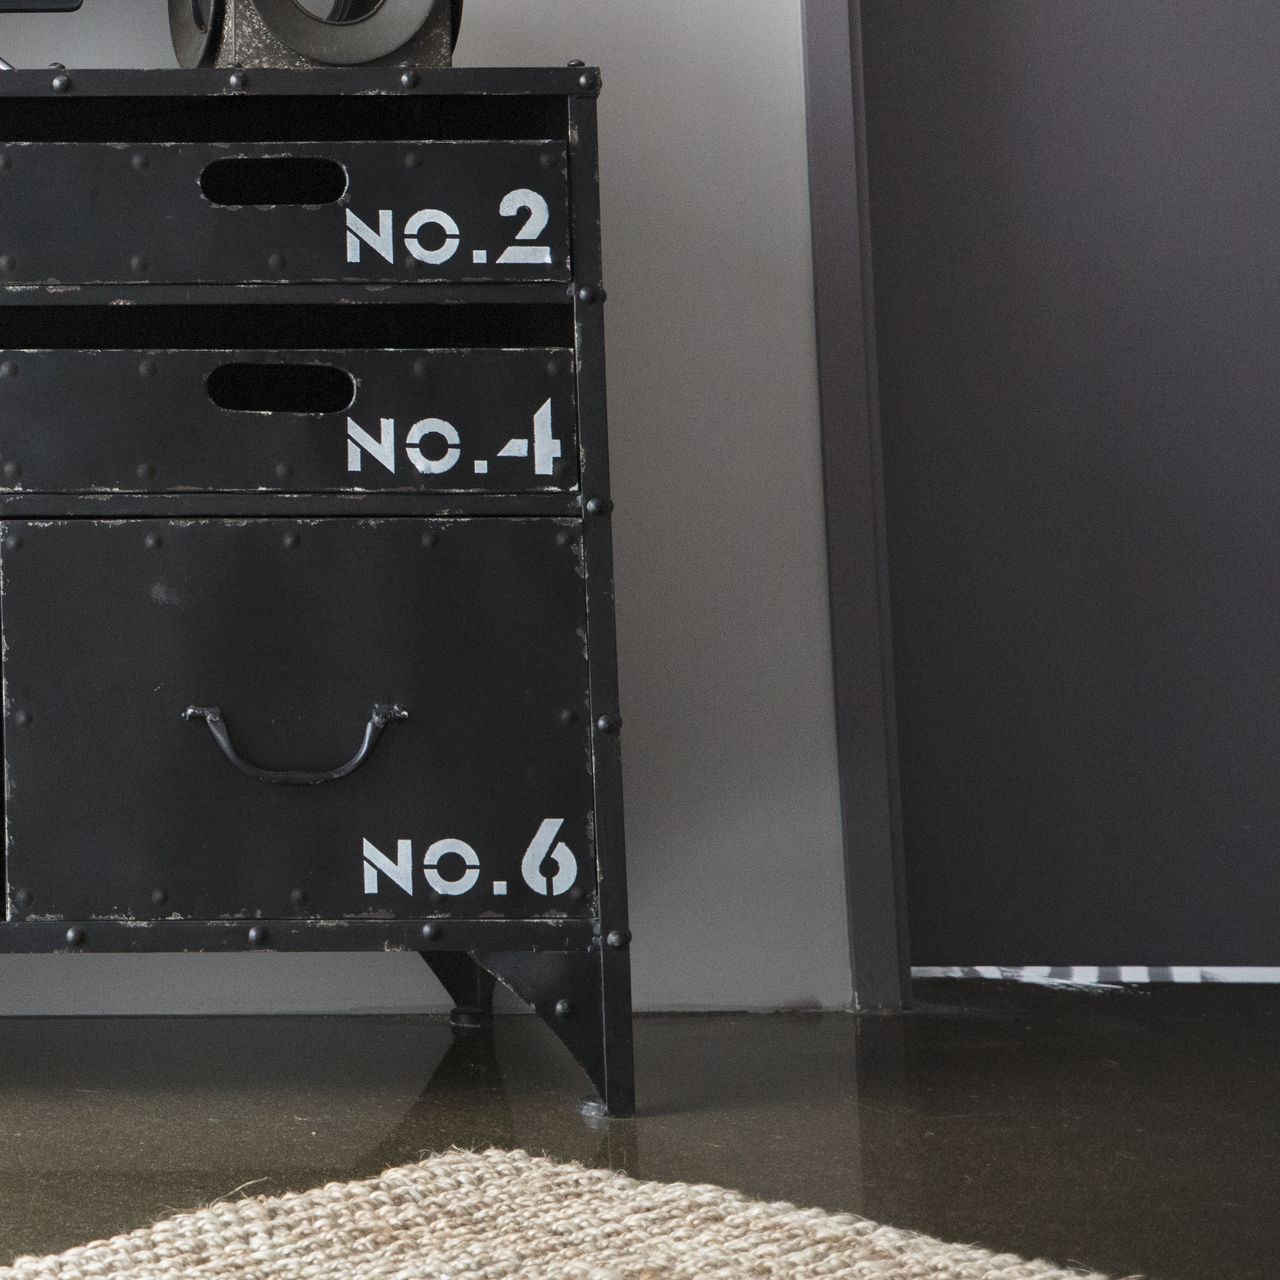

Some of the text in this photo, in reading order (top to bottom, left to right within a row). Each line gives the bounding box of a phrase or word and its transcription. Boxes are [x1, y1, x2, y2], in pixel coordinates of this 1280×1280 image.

[344, 187, 554, 266] NO.2
[346, 396, 563, 477] NO.4
[361, 817, 579, 898] NO.6
